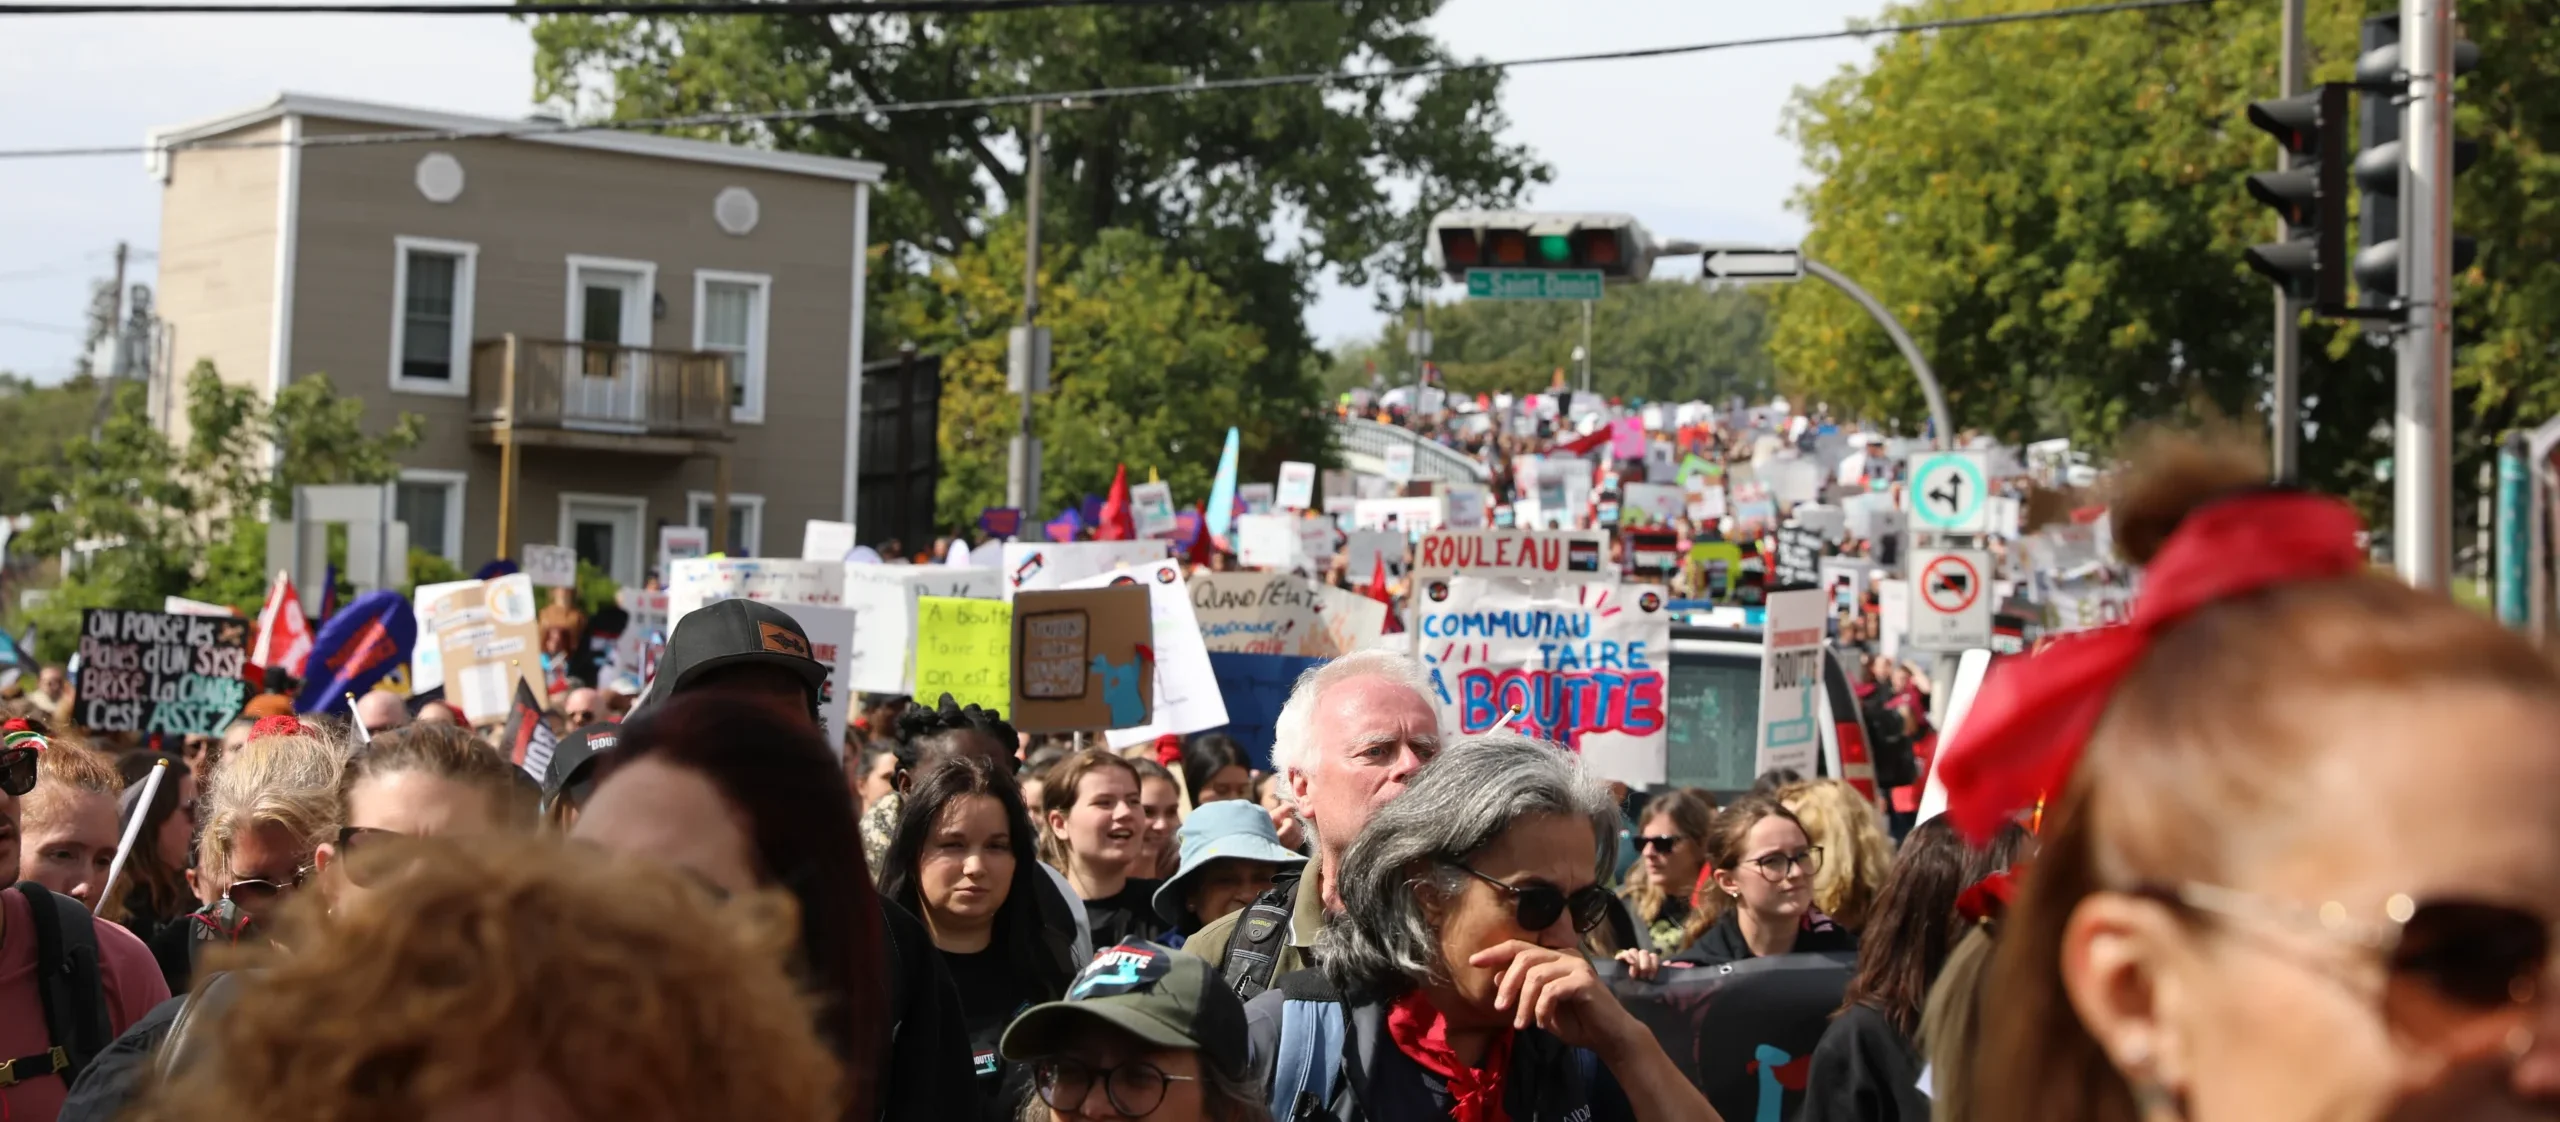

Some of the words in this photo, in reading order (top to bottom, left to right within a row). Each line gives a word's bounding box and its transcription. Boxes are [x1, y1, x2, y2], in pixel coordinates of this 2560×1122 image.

[1422, 535, 1561, 571] ROULEAU
[1194, 580, 1256, 608] QUAND
[89, 610, 118, 638] ON
[1539, 640, 1649, 670] TAIRE
[1463, 673, 1656, 730] BOUTTE
[147, 703, 235, 738] ASSEZ
